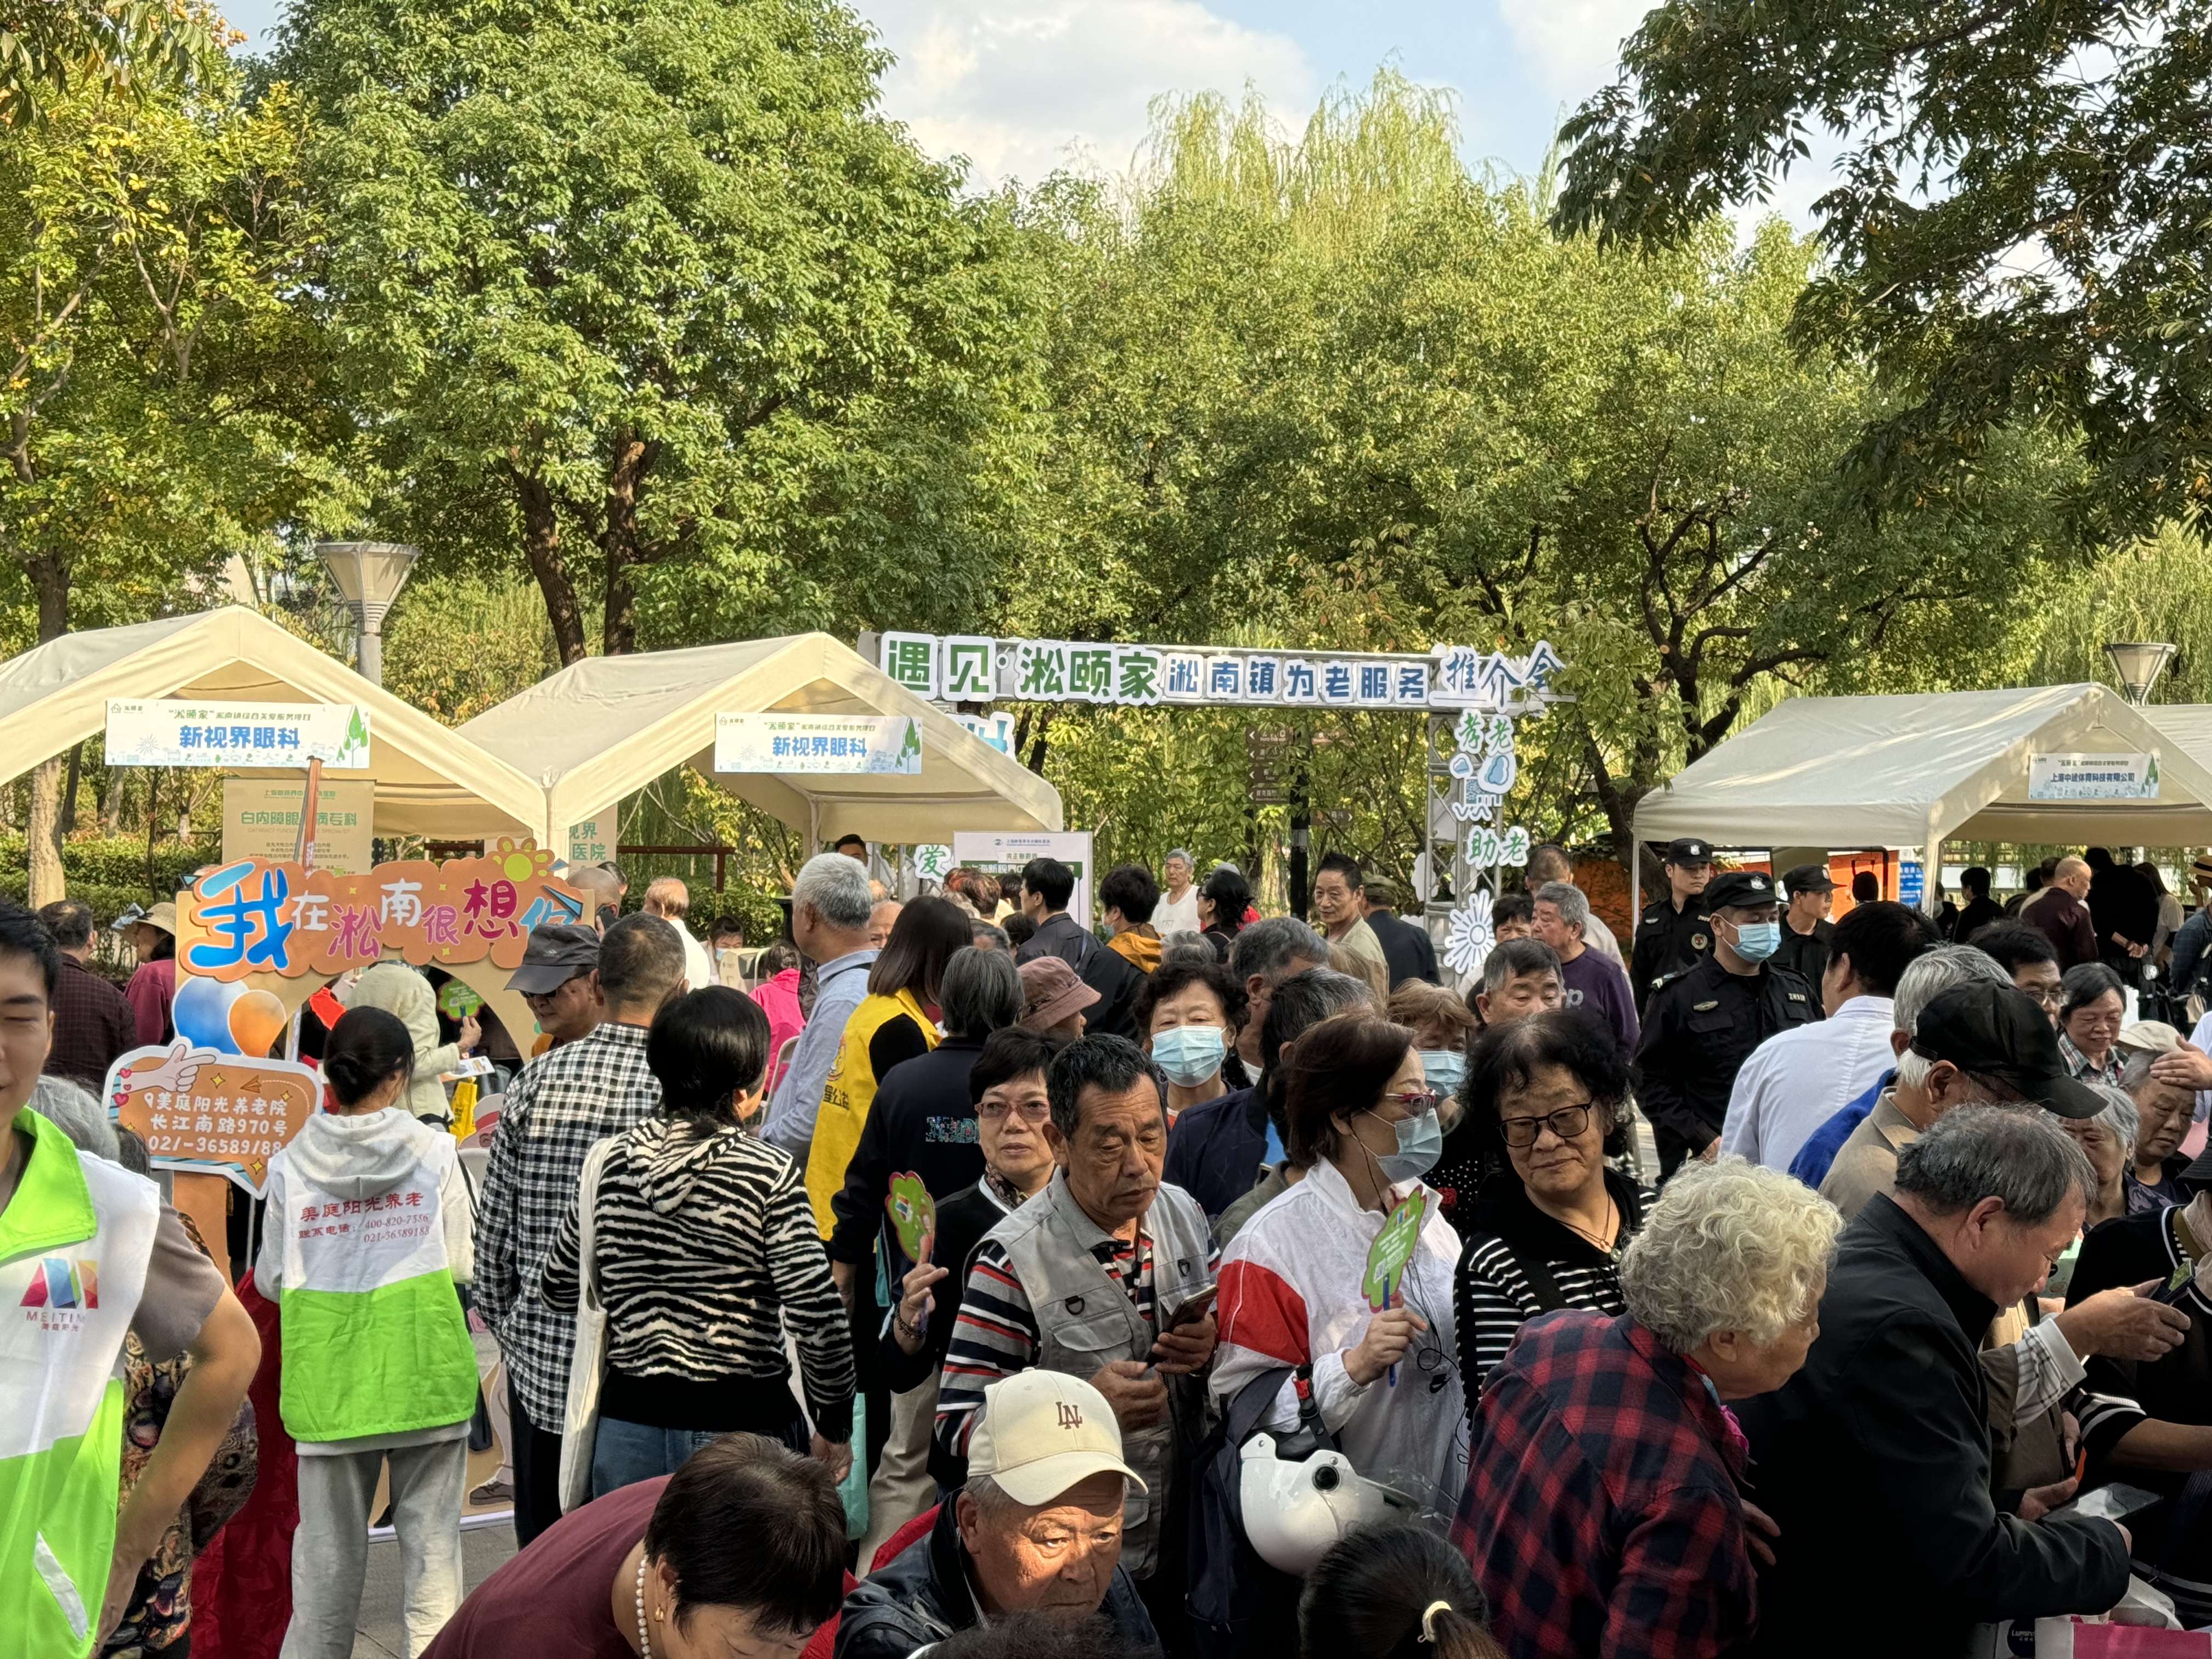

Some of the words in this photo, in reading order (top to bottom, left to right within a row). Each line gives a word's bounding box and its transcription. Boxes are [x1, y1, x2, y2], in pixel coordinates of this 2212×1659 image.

[179, 725, 301, 750] 新视界眼科
[1458, 712, 1512, 752] 孝老
[771, 735, 867, 757] 新视界眼科
[241, 810, 358, 826] 白内障眼病专科
[572, 843, 606, 861] 医院
[1469, 830, 1526, 867] 助老
[156, 1092, 288, 1117] 美庭阳光养老院
[150, 1114, 288, 1137] 长江南路970号
[300, 1191, 424, 1222] 美庭阳光养老
[364, 1226, 430, 1244] 021-36589188
